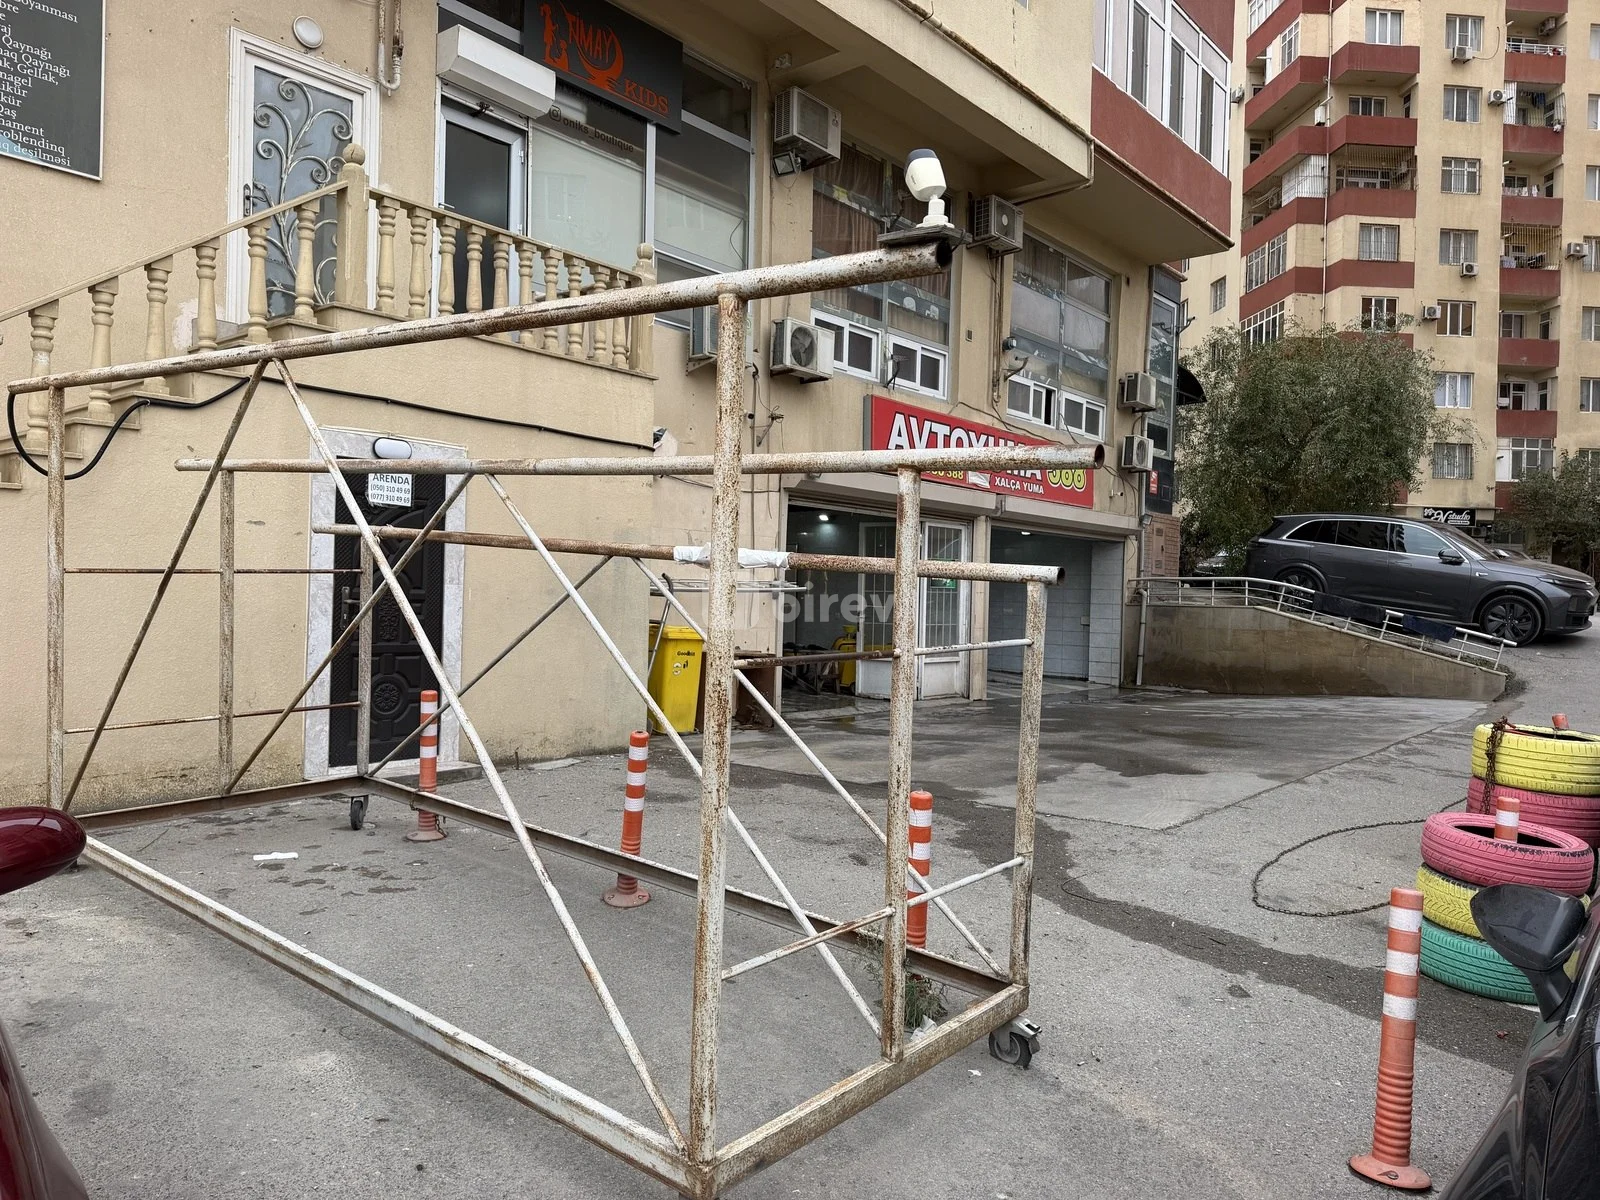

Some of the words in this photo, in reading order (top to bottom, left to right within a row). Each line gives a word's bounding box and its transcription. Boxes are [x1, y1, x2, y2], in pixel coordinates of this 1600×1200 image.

[14, 0, 79, 23] oyanması
[2, 35, 52, 60] Qaynağı
[21, 53, 71, 77] Qaynağı
[623, 78, 669, 115] KIDS
[372, 473, 410, 485] ARENDA
[994, 476, 1021, 491] XALÇA
[1022, 481, 1045, 495] YUMA
